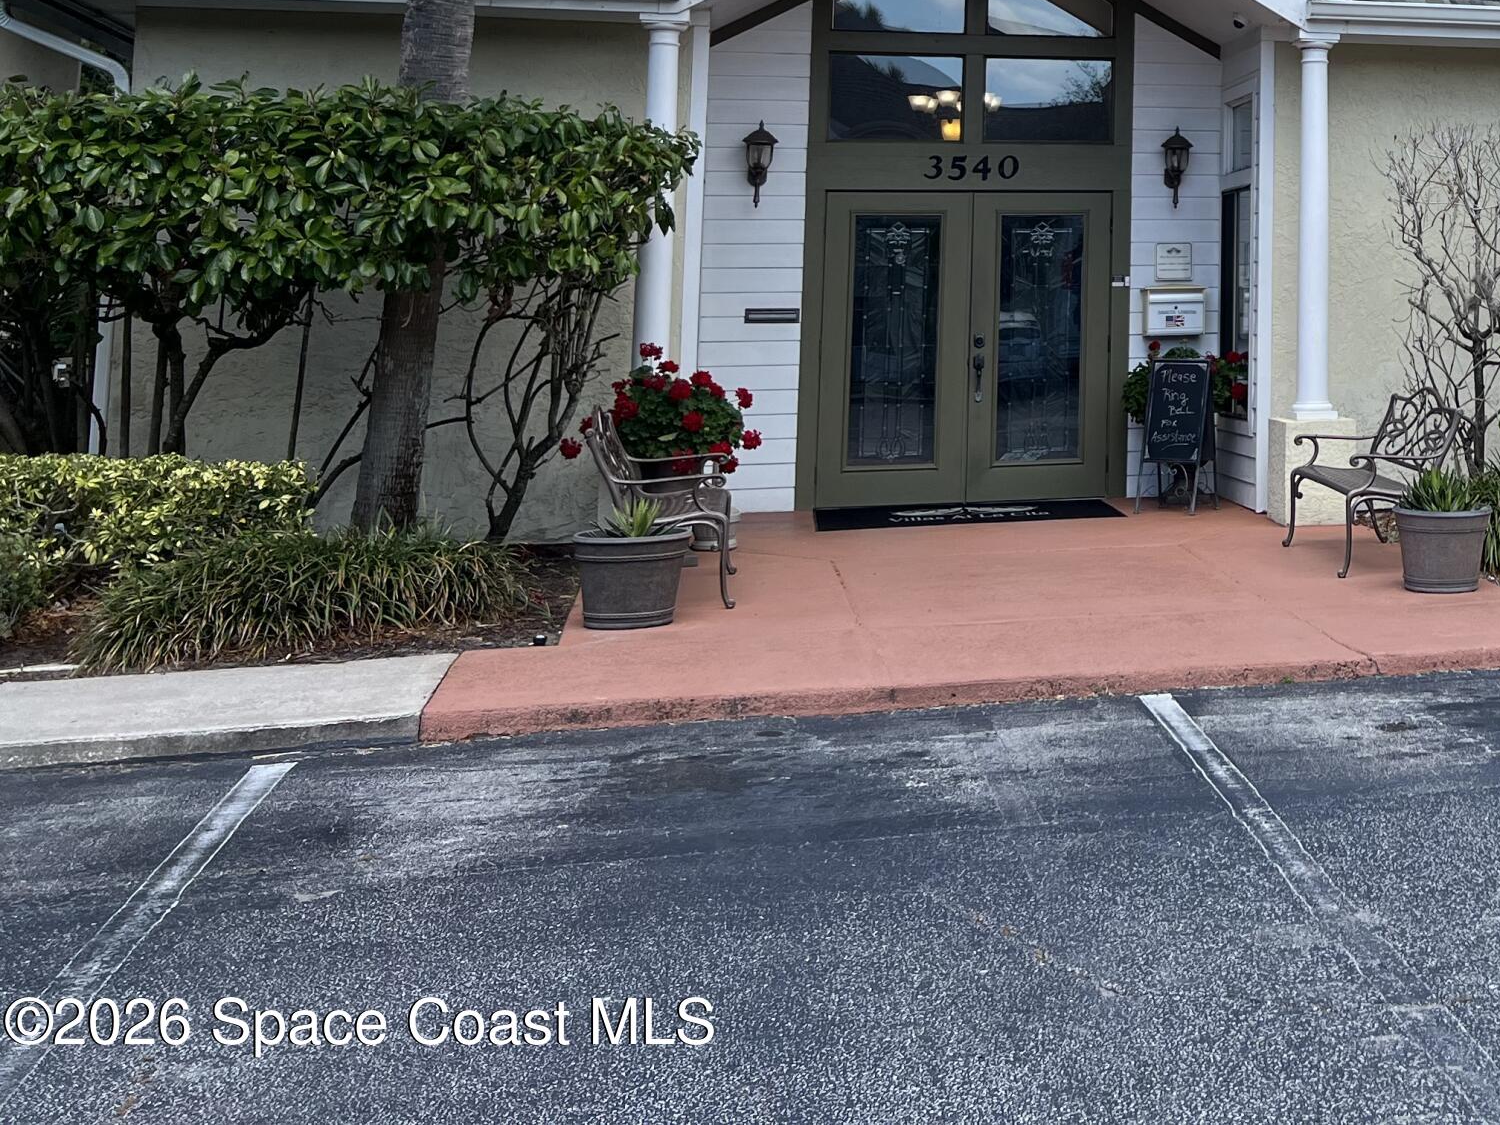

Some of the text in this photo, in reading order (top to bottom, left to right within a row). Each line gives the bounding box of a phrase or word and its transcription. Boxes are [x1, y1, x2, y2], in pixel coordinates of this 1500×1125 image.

[923, 154, 1020, 182] 3540
[1161, 369, 1198, 384] Please
[1161, 387, 1190, 407] Ring
